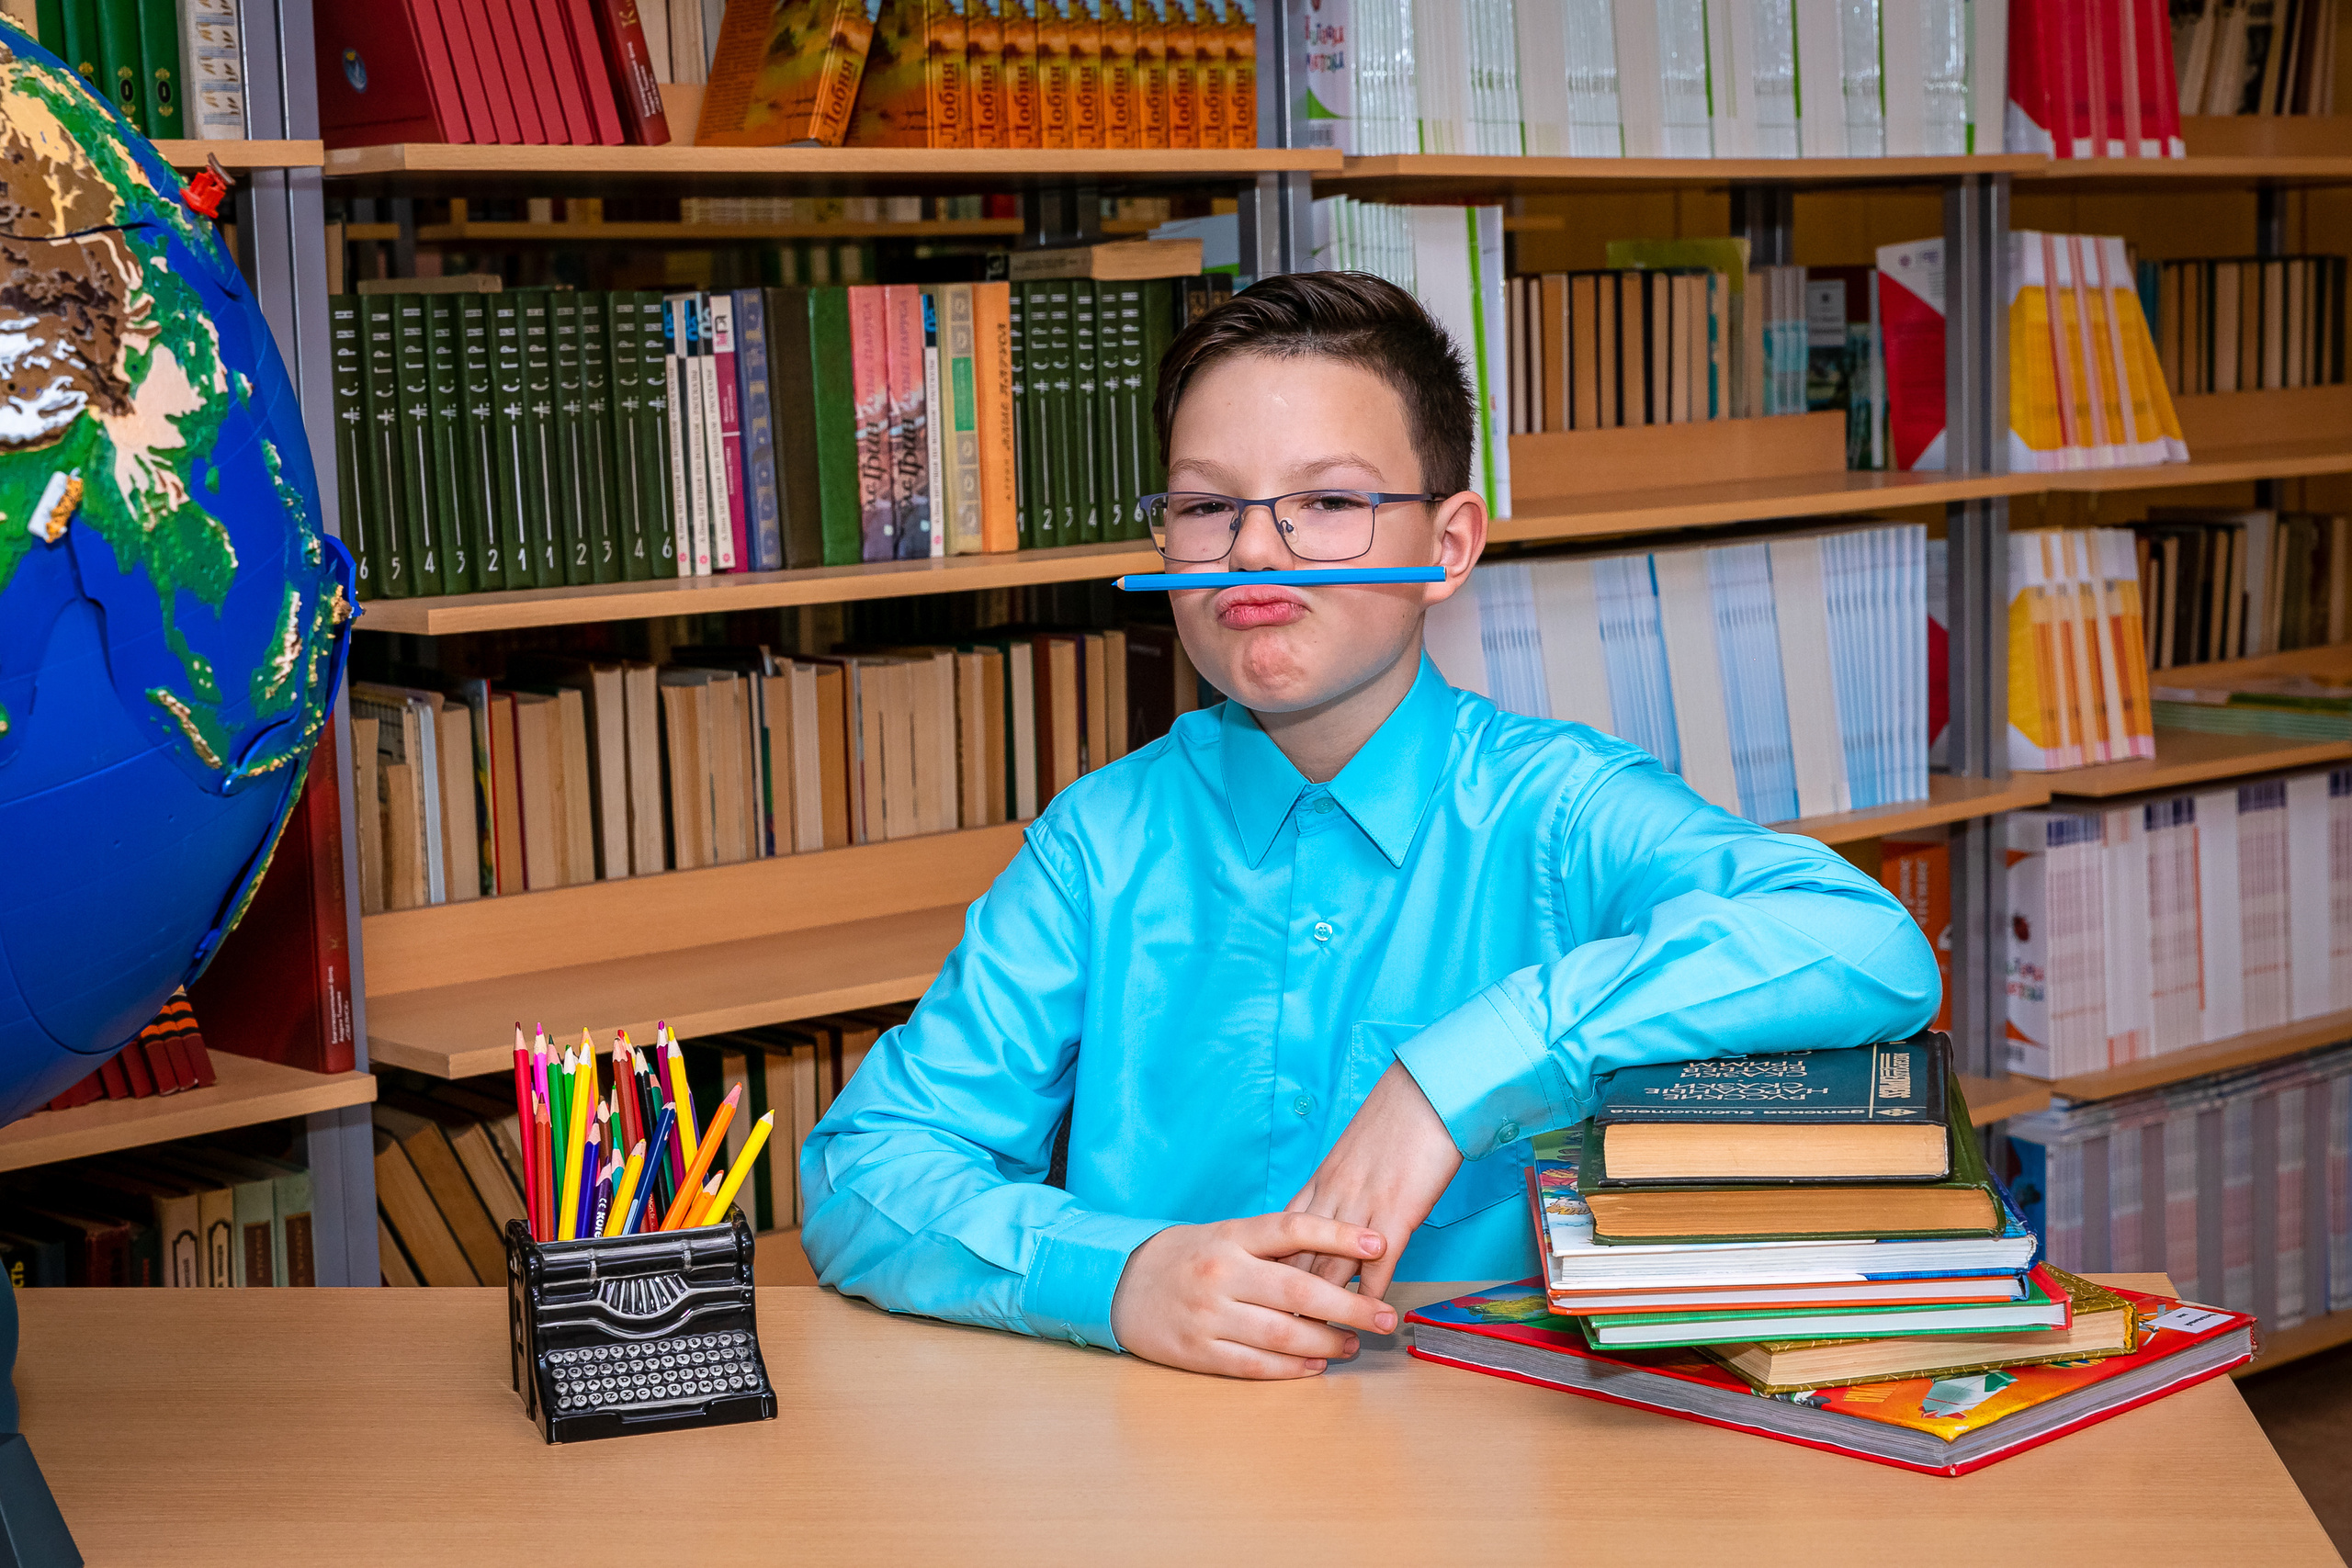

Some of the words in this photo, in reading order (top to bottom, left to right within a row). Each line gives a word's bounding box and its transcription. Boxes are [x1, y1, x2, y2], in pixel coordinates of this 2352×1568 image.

[1042, 508, 1053, 531] 2
[1064, 506, 1074, 528] 3
[1087, 508, 1098, 528] 4
[1113, 503, 1123, 525] 5
[1133, 501, 1145, 523] 6
[545, 545, 555, 570] 1
[575, 542, 587, 566] 2
[602, 540, 613, 563] 3
[634, 537, 645, 559] 4
[662, 536, 673, 559] 6
[358, 556, 369, 581] 6
[391, 557, 401, 581] 5
[424, 550, 436, 574] 4
[456, 550, 466, 574] 3
[487, 548, 499, 572] 2
[517, 547, 527, 572] 1
